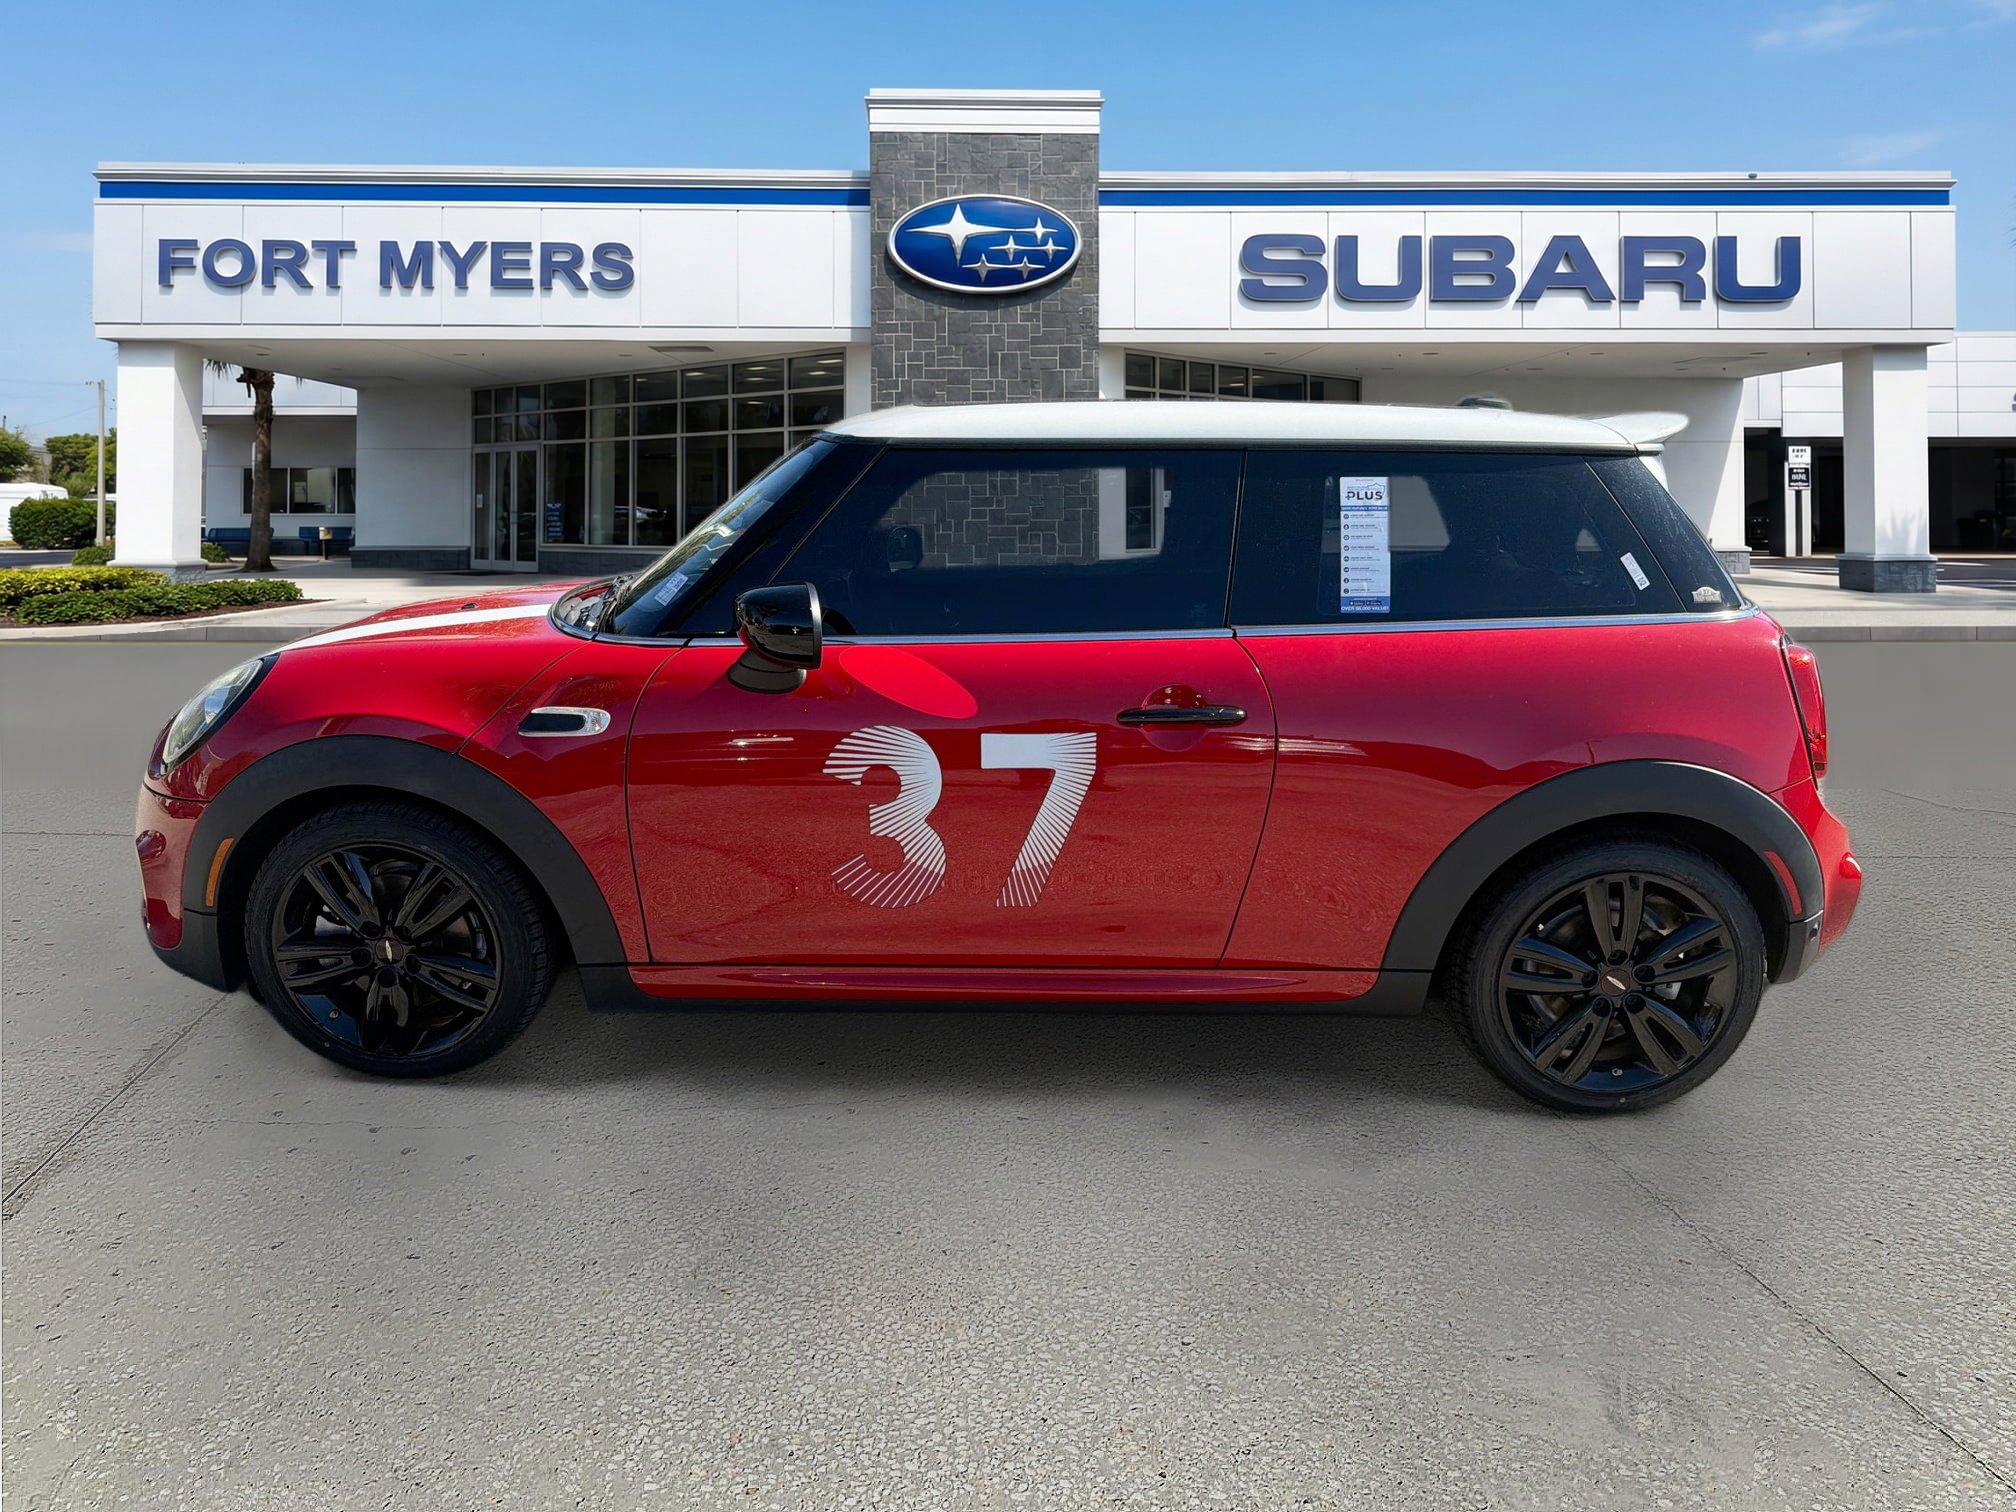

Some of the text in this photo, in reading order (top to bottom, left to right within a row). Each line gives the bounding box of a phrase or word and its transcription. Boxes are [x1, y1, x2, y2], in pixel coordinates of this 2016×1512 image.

[158, 238, 635, 290] FORT MYERS
[1239, 233, 1802, 304] SUBARU
[1345, 491, 1383, 501] PLUS
[822, 725, 1097, 908] 37
